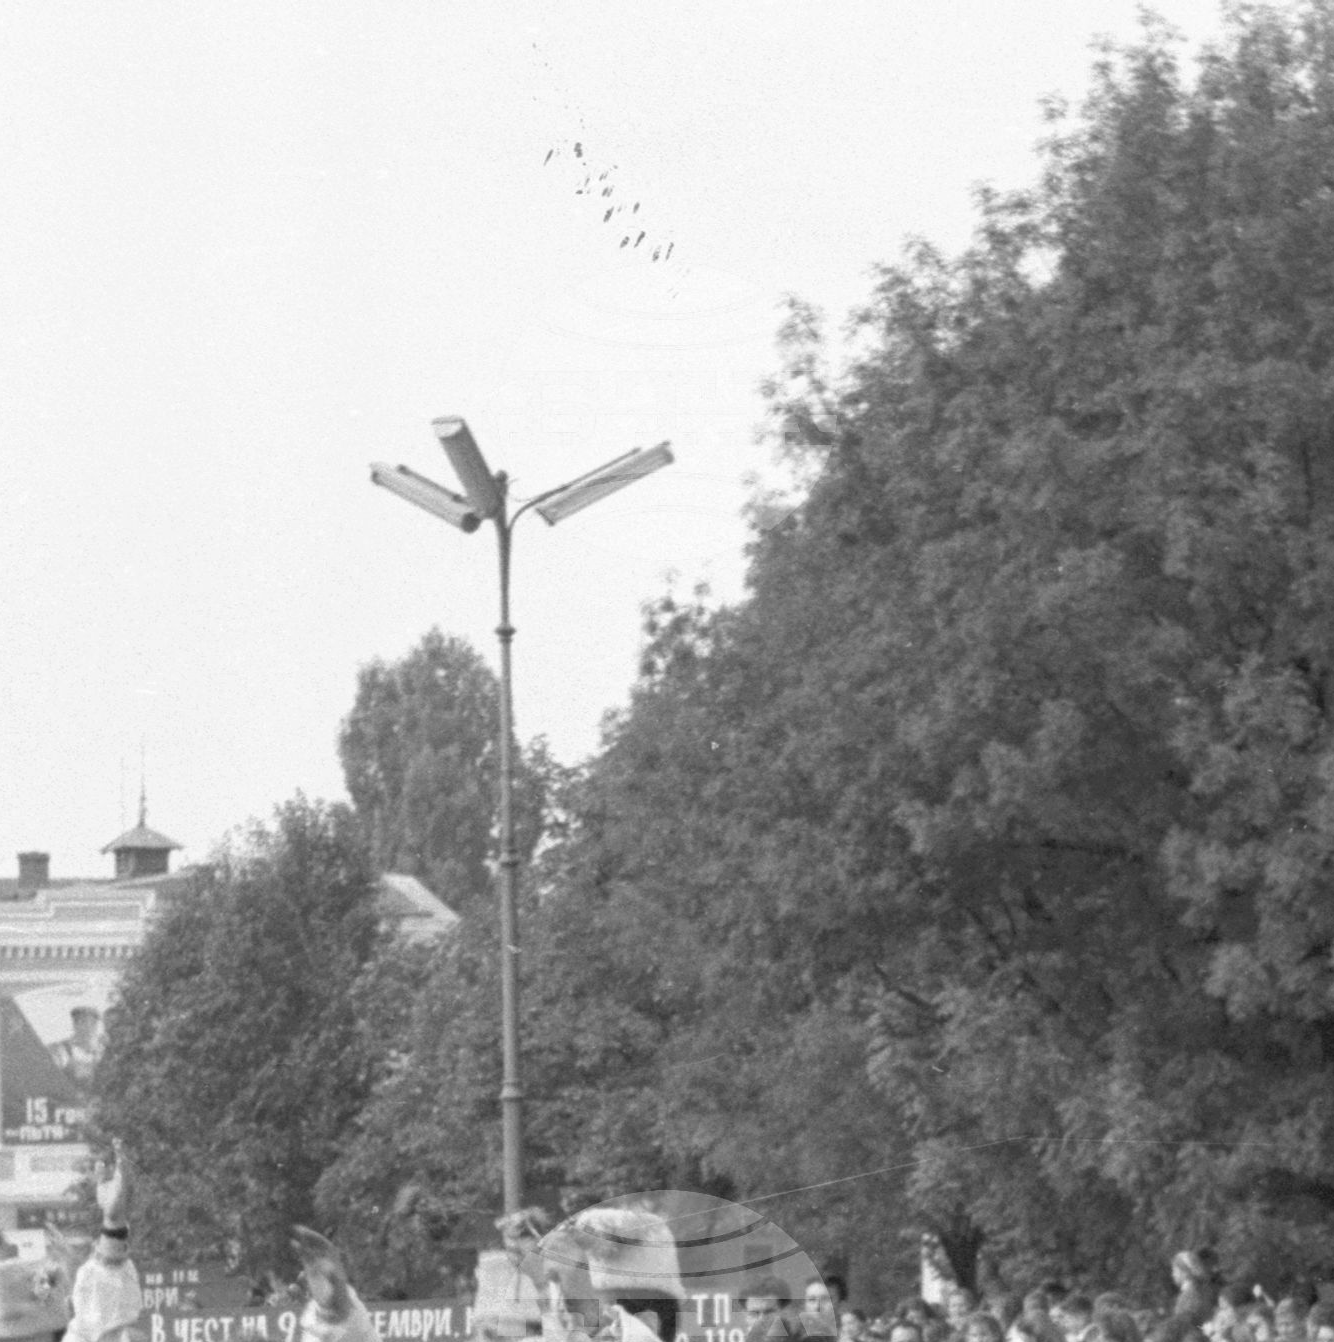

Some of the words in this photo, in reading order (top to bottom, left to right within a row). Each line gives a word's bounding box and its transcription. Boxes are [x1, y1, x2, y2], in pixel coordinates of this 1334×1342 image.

[25, 1096, 49, 1124] 15
[241, 1314, 269, 1339] НА
[371, 1306, 461, 1342] ЕМВРИ.
